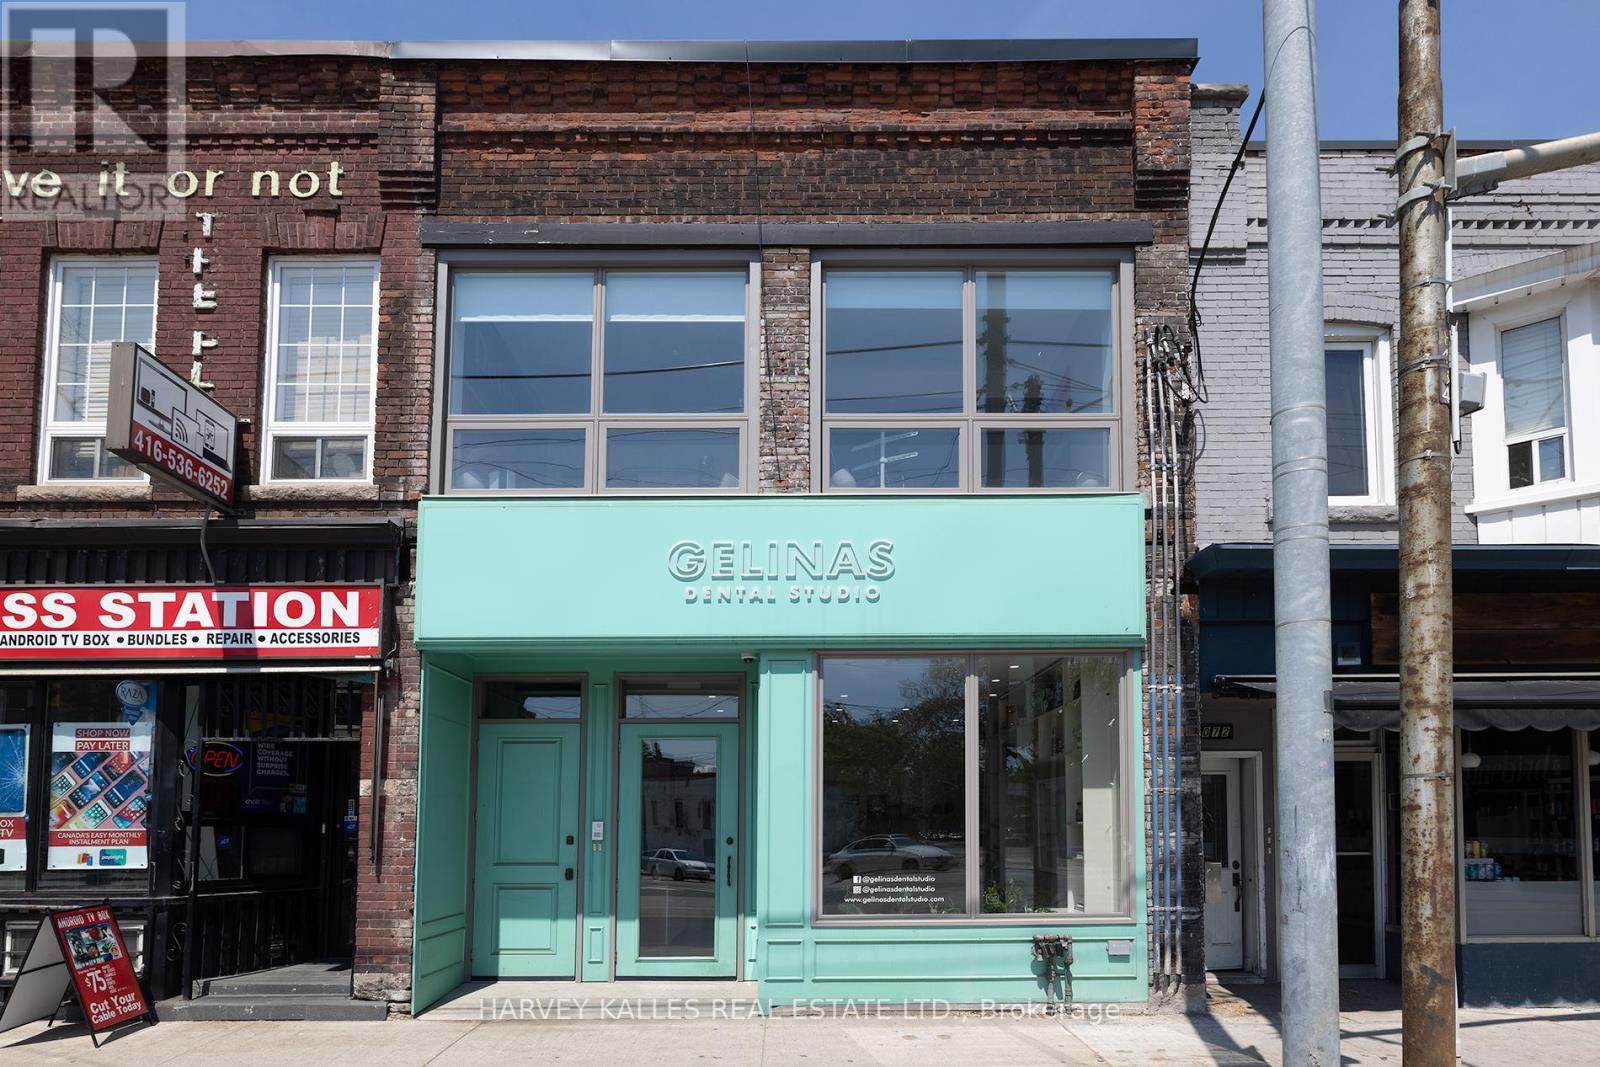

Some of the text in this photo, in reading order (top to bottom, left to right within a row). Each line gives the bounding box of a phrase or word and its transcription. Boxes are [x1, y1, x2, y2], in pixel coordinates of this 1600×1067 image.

[98, 160, 130, 196] it
[167, 169, 224, 198] or
[252, 160, 344, 198] not
[133, 429, 229, 500] 416-536-6252
[668, 539, 896, 582] GELINAS
[684, 585, 881, 604] DENTAL STUDIO
[1, 590, 360, 629] SS STATION
[0, 631, 361, 647] ANDROID TV BOX BUNDLES REPAIR ACCESSORIES
[77, 729, 129, 738] SHOP NOW
[77, 741, 129, 750] PAY LATER
[862, 875, 936, 884] @gelinasdentalstudio
[862, 885, 936, 894] @gelinasdentalstudio
[844, 895, 945, 905] www.gelinasdentalstudio.com
[58, 910, 111, 928] ANDROID TV BOX
[90, 992, 136, 1014] Cut Your
[91, 1001, 142, 1025] Cable Today
